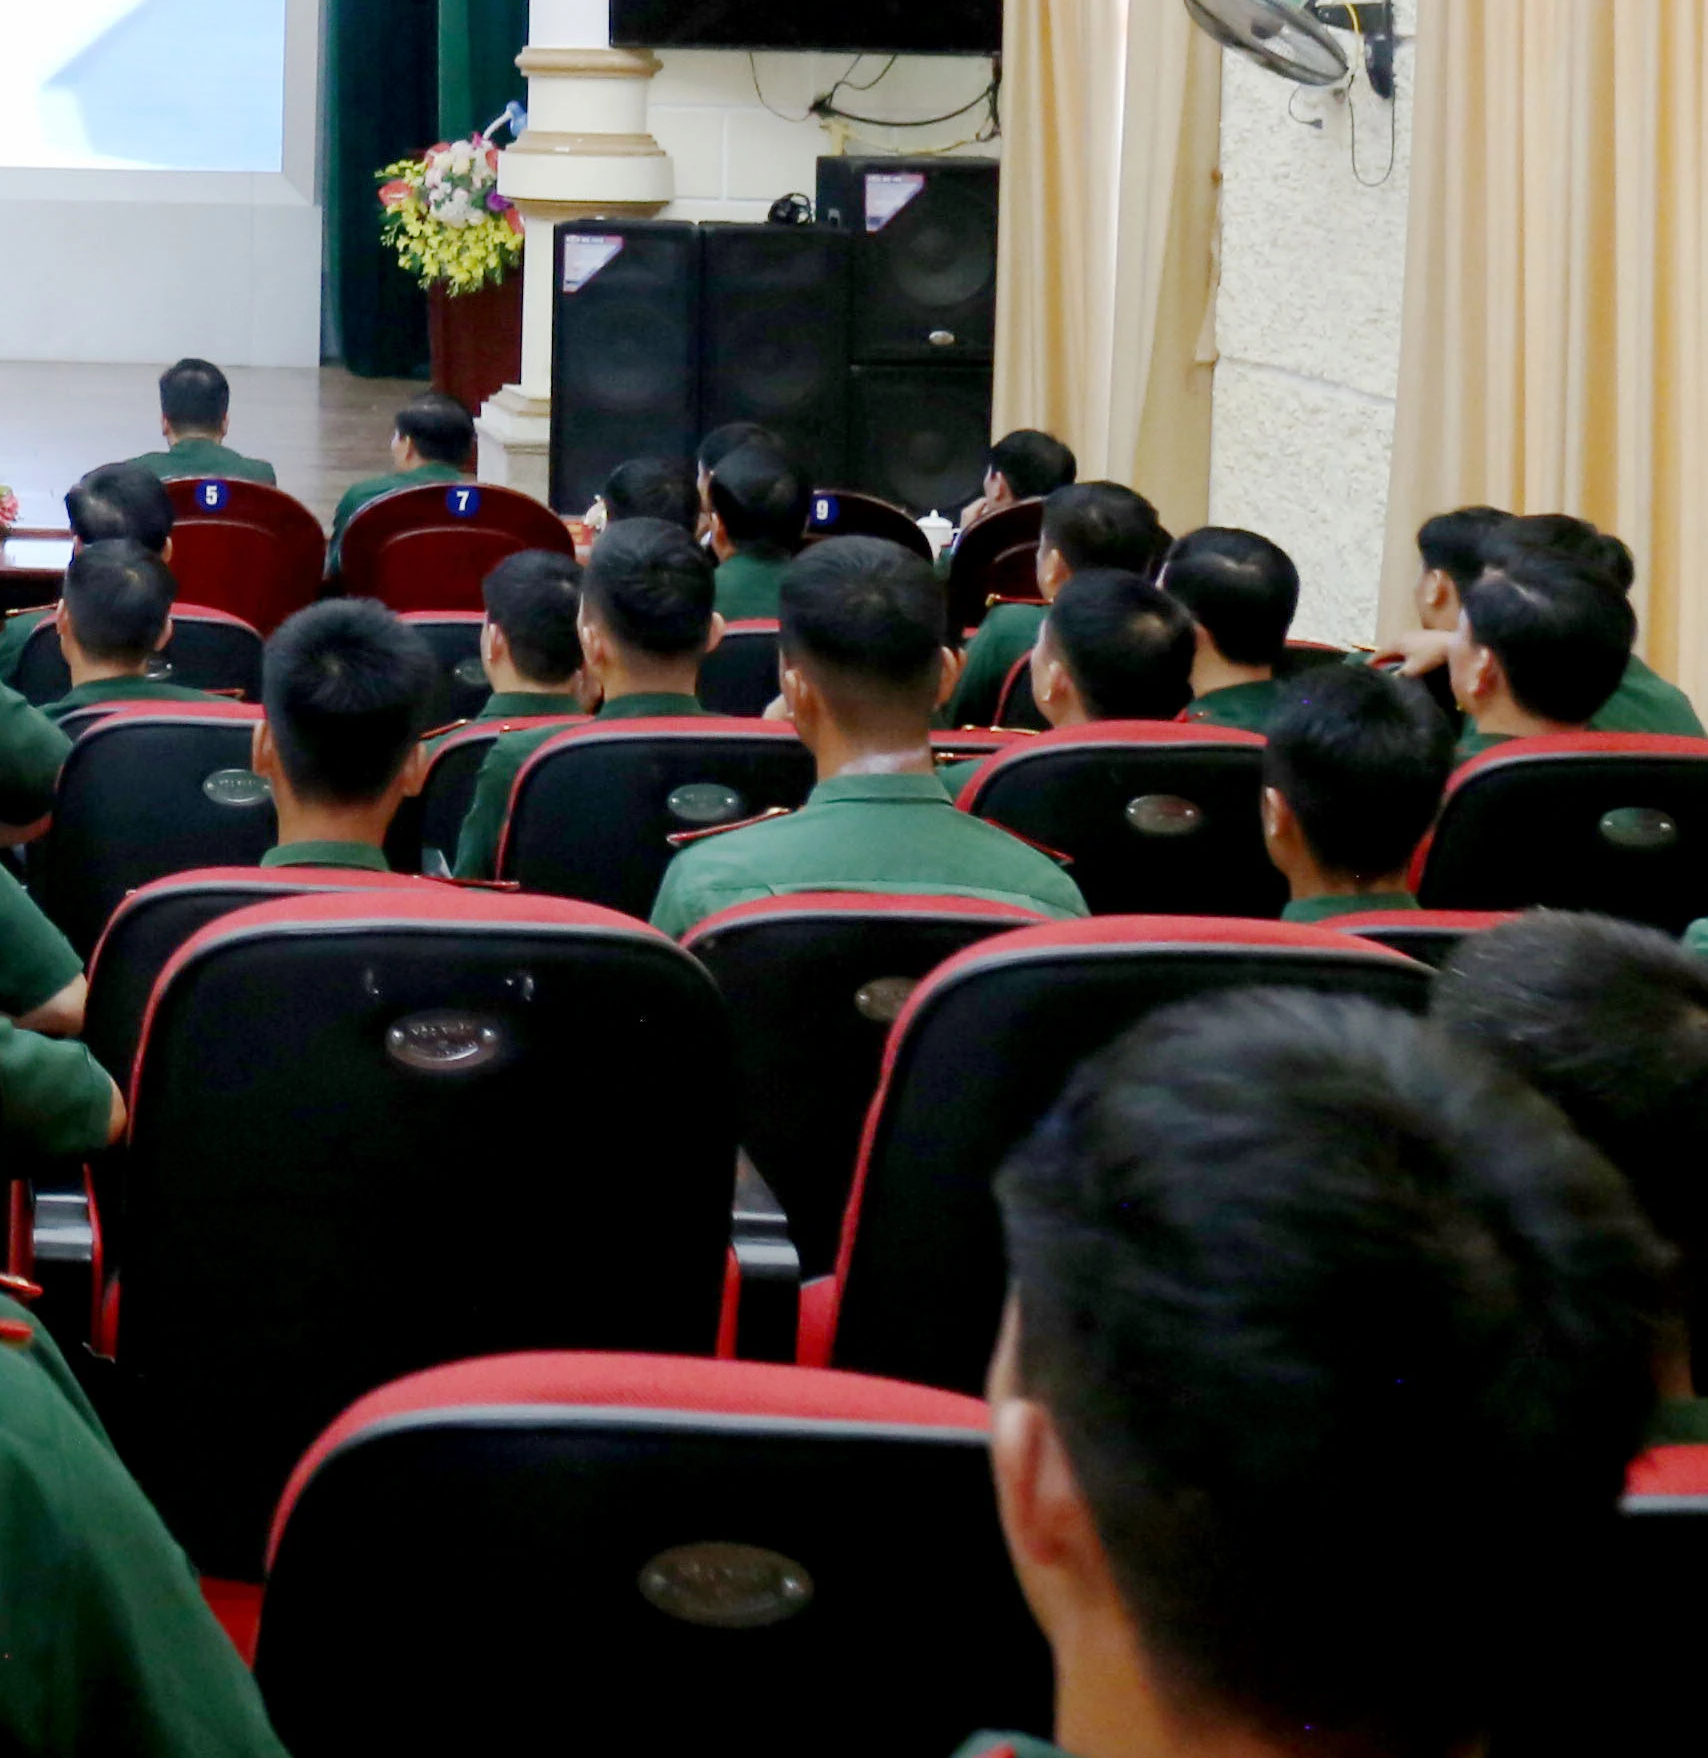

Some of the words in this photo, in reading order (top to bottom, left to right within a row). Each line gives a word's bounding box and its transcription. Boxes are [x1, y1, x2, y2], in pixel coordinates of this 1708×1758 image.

[206, 486, 217, 505] 5
[457, 491, 470, 511] 7
[817, 500, 828, 520] 9
